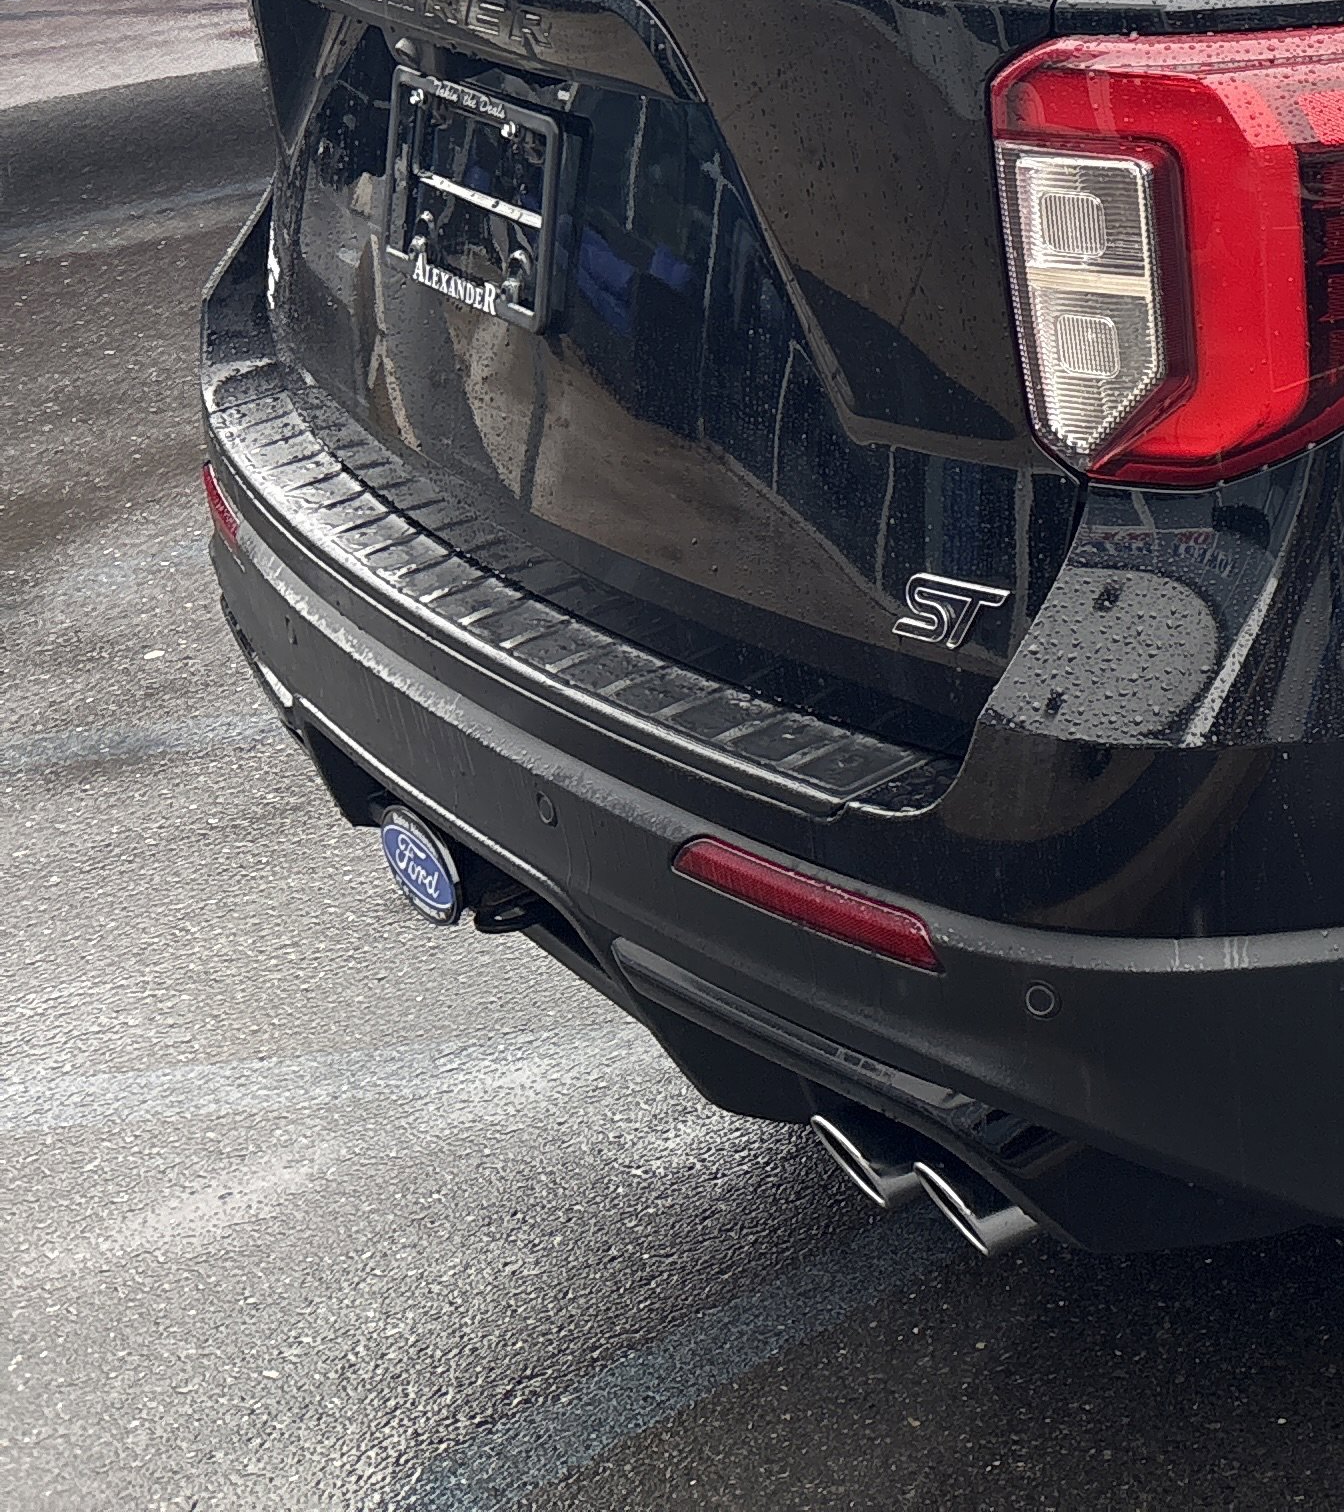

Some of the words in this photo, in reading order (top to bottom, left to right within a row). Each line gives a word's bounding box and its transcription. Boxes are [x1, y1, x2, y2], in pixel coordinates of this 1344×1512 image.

[462, 90, 477, 109] the
[480, 94, 506, 120] Deals
[412, 252, 497, 316] ALEXANDER
[892, 572, 1011, 650] ST
[395, 833, 441, 899] Ford
